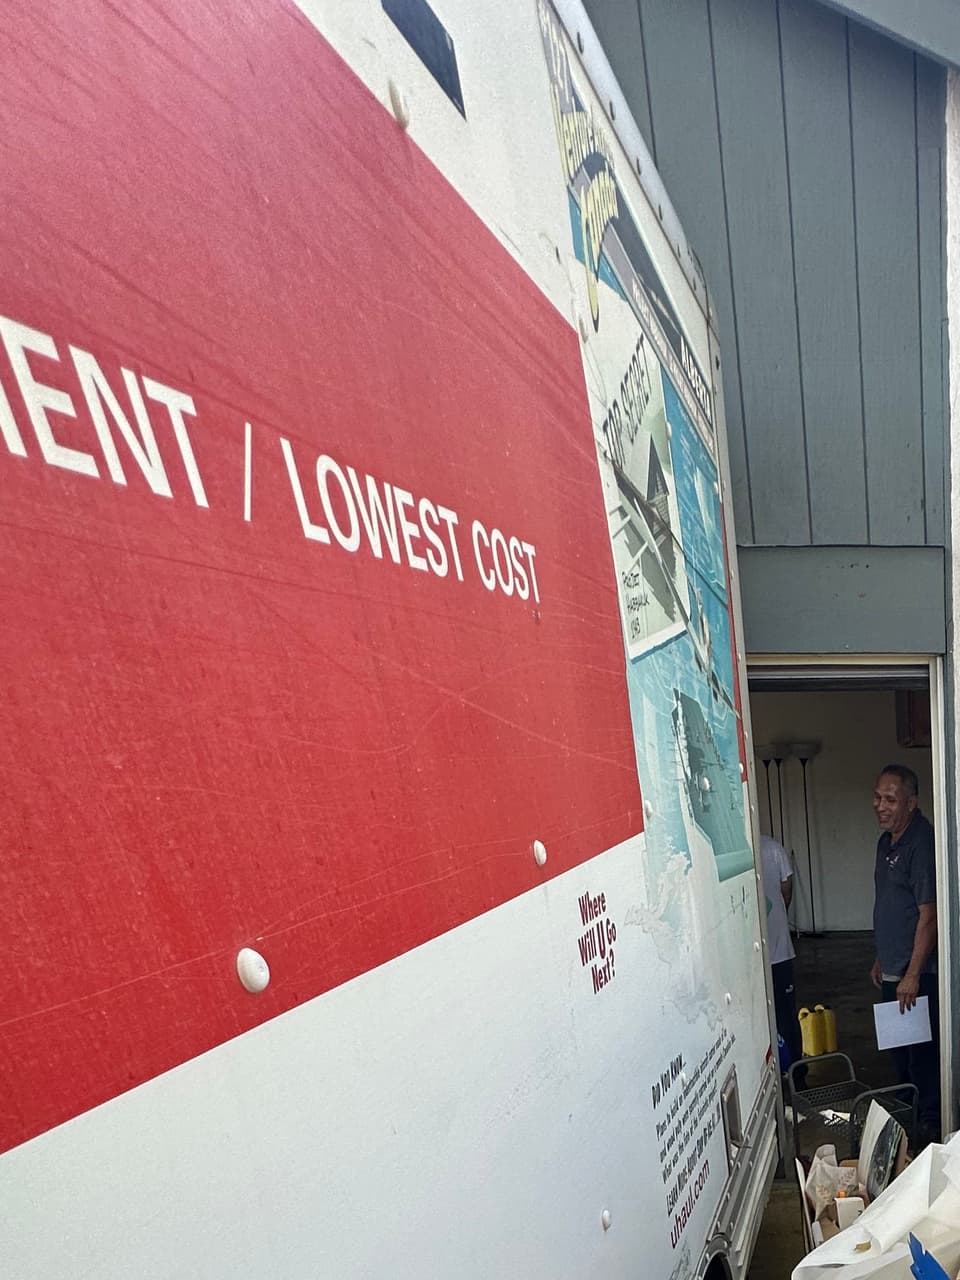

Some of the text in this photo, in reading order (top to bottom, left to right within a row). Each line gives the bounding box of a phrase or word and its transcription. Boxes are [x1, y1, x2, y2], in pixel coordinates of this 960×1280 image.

[0, 316, 209, 508] ENT
[279, 436, 464, 582] LOWEST
[471, 519, 541, 604] COST
[577, 890, 607, 926] Where
[577, 917, 617, 967] Will U Go
[591, 948, 617, 995] Next?
[670, 1159, 710, 1250] uhaul.com
